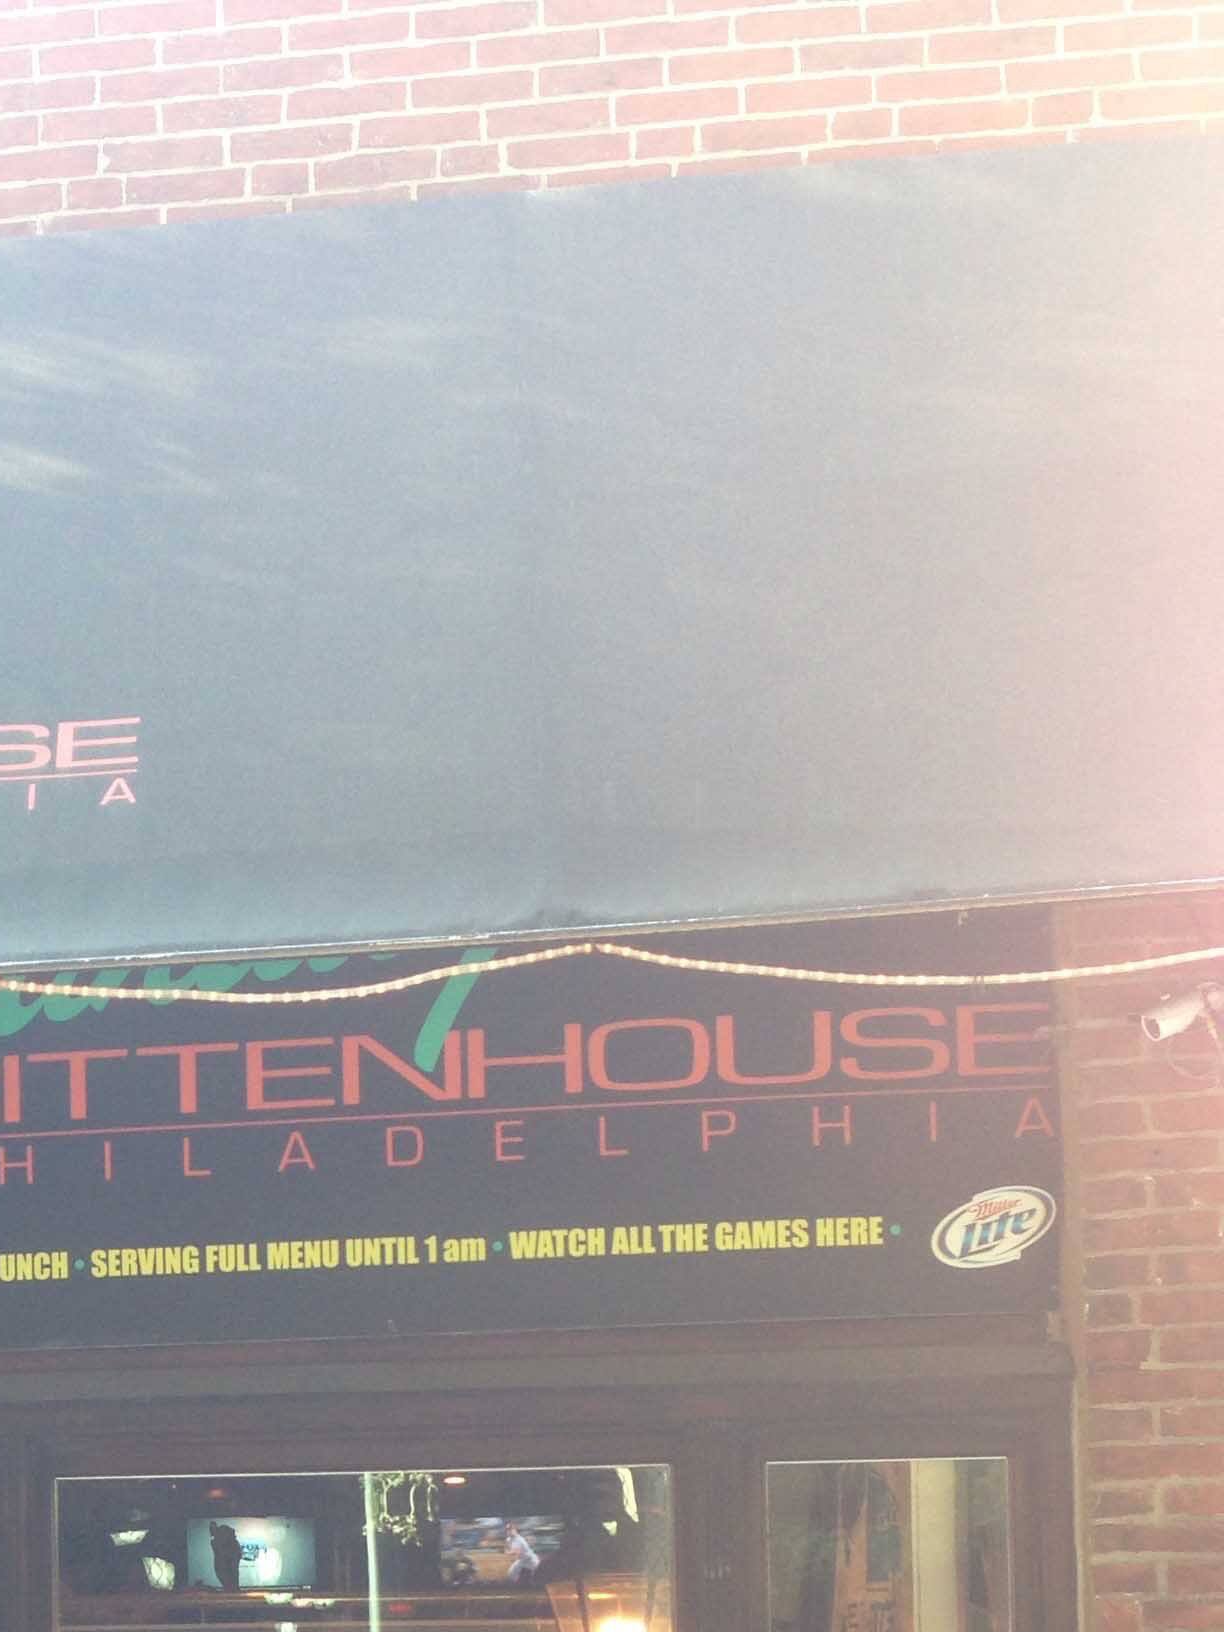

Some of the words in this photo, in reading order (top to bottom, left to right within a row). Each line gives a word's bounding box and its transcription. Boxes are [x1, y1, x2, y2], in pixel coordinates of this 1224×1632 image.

[91, 1246, 201, 1279] SERVING
[206, 1243, 262, 1274] FULL
[267, 1239, 340, 1270] MENU
[346, 1235, 420, 1268] UNTIL
[424, 1234, 438, 1264] 1
[443, 1236, 488, 1263] am
[509, 1225, 605, 1260] WATCH
[610, 1225, 656, 1256] ALL
[657, 1222, 709, 1255] THE
[714, 1218, 811, 1251] GAMES
[815, 1215, 884, 1248] HERE
[959, 1205, 1038, 1259] Lite
